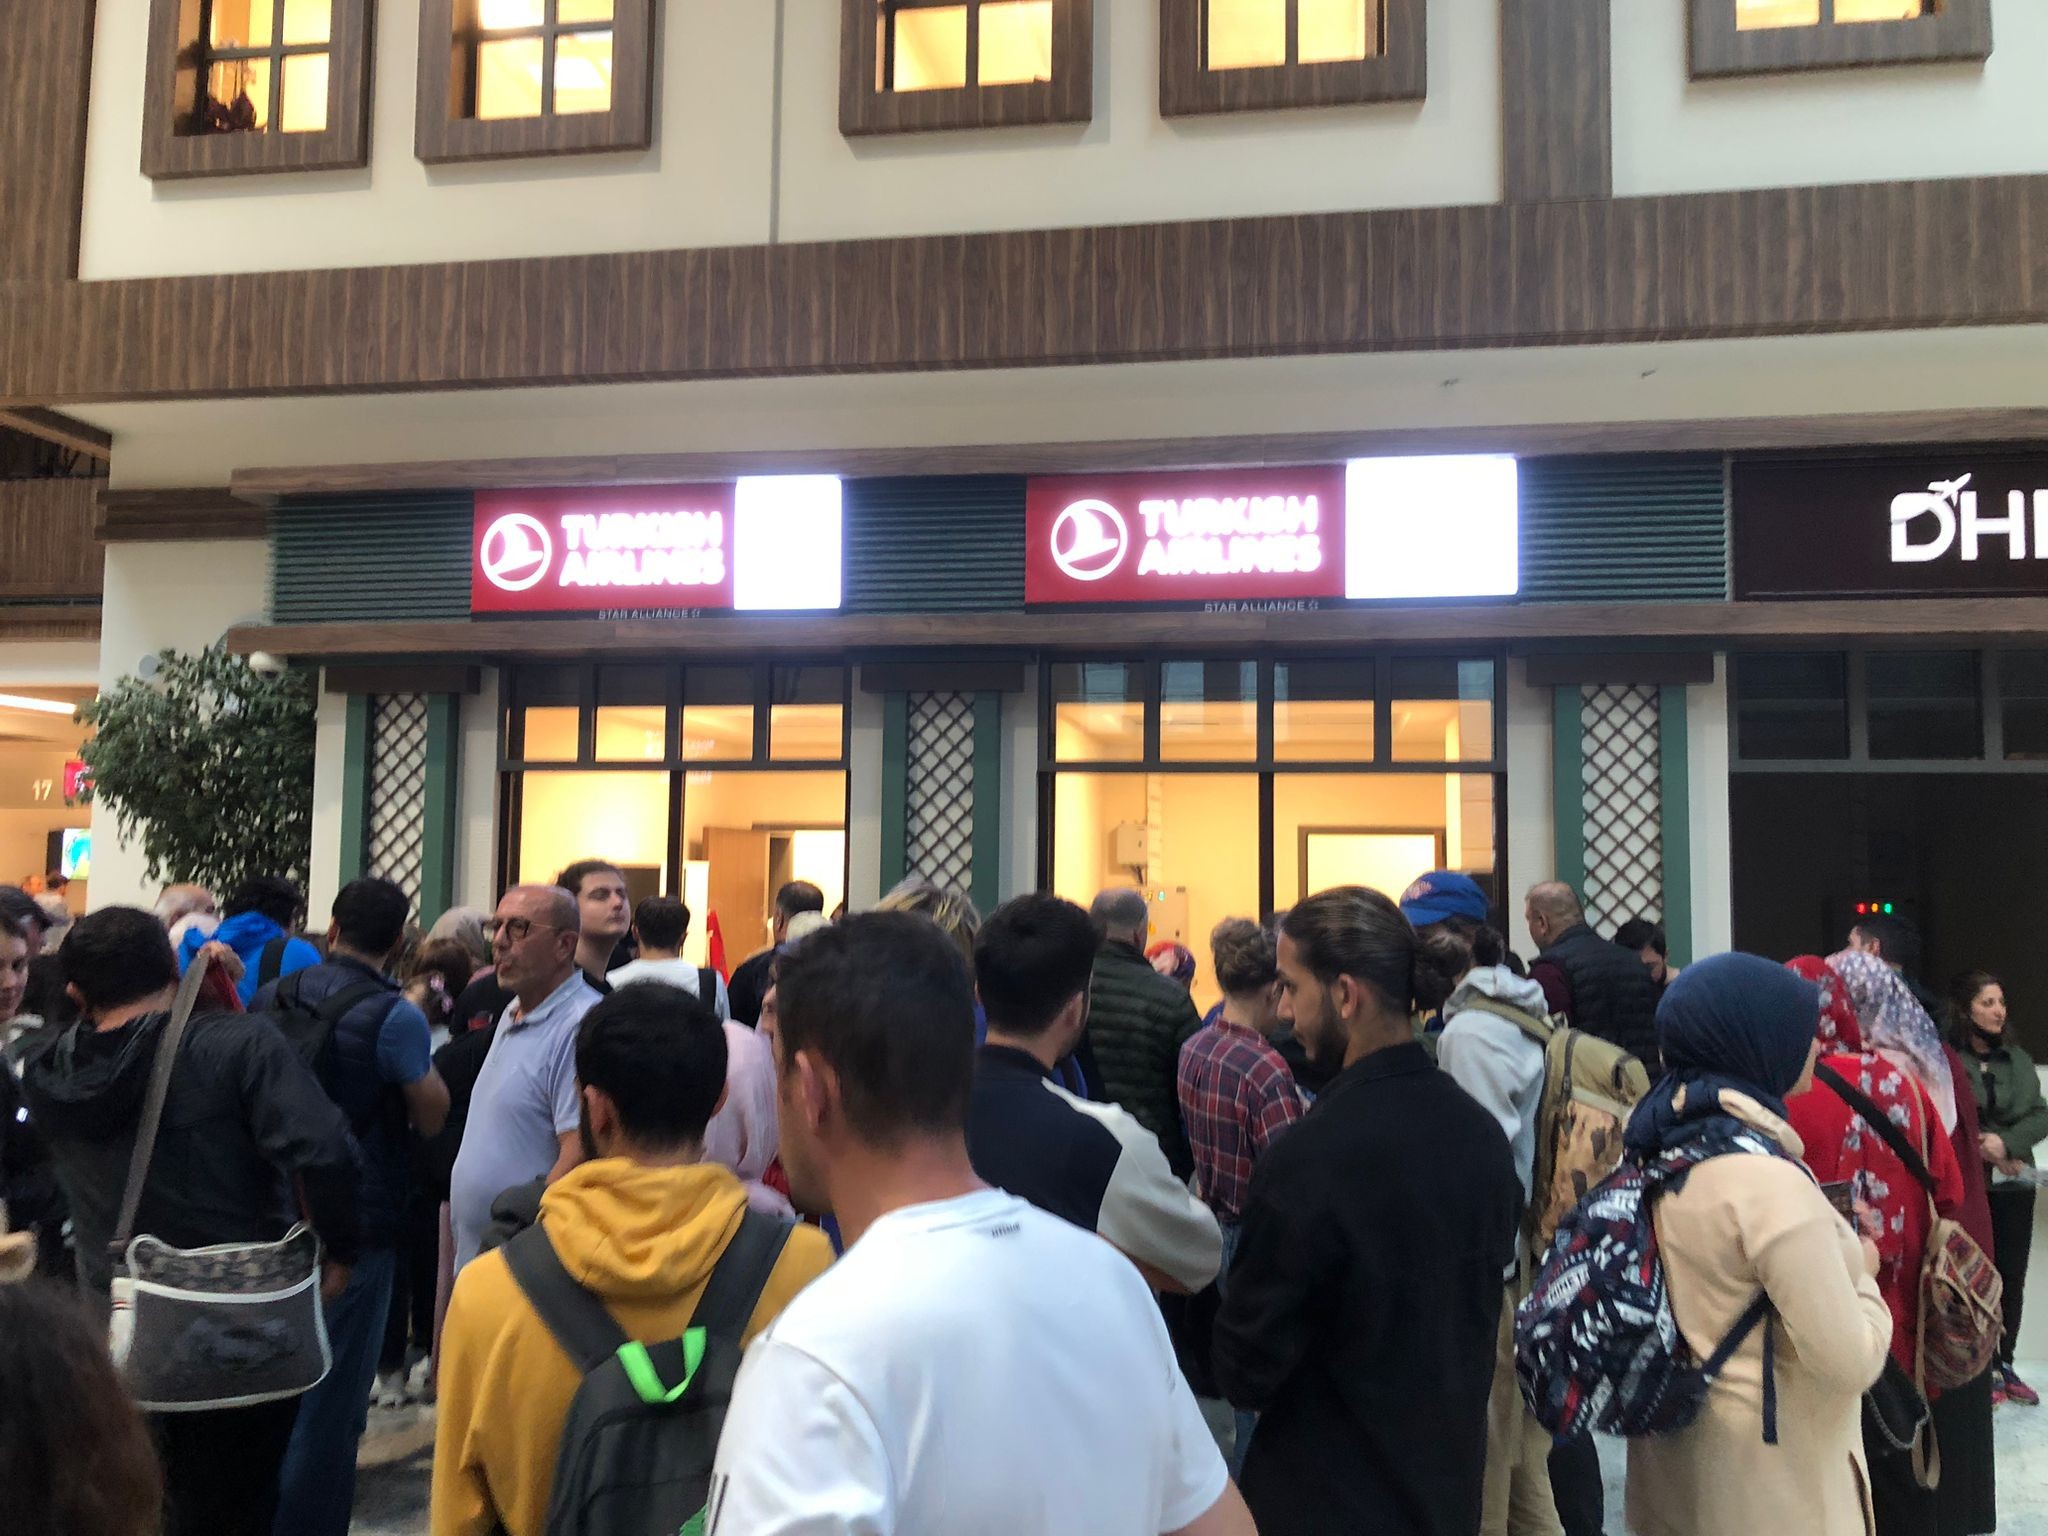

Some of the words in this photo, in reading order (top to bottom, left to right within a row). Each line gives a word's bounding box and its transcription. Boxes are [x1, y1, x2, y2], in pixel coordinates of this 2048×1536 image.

[560, 511, 724, 549] TURKISH
[1138, 495, 1319, 536] TURKISH
[1890, 487, 2048, 563] DH
[558, 548, 726, 587] AIRLINES
[1137, 534, 1322, 576] AIRLINES
[598, 608, 628, 620] STAR
[631, 607, 688, 619] ALLIANCE
[1204, 601, 1237, 613] STAR
[1240, 599, 1305, 613] ALLIANCE
[32, 778, 53, 801] 17
